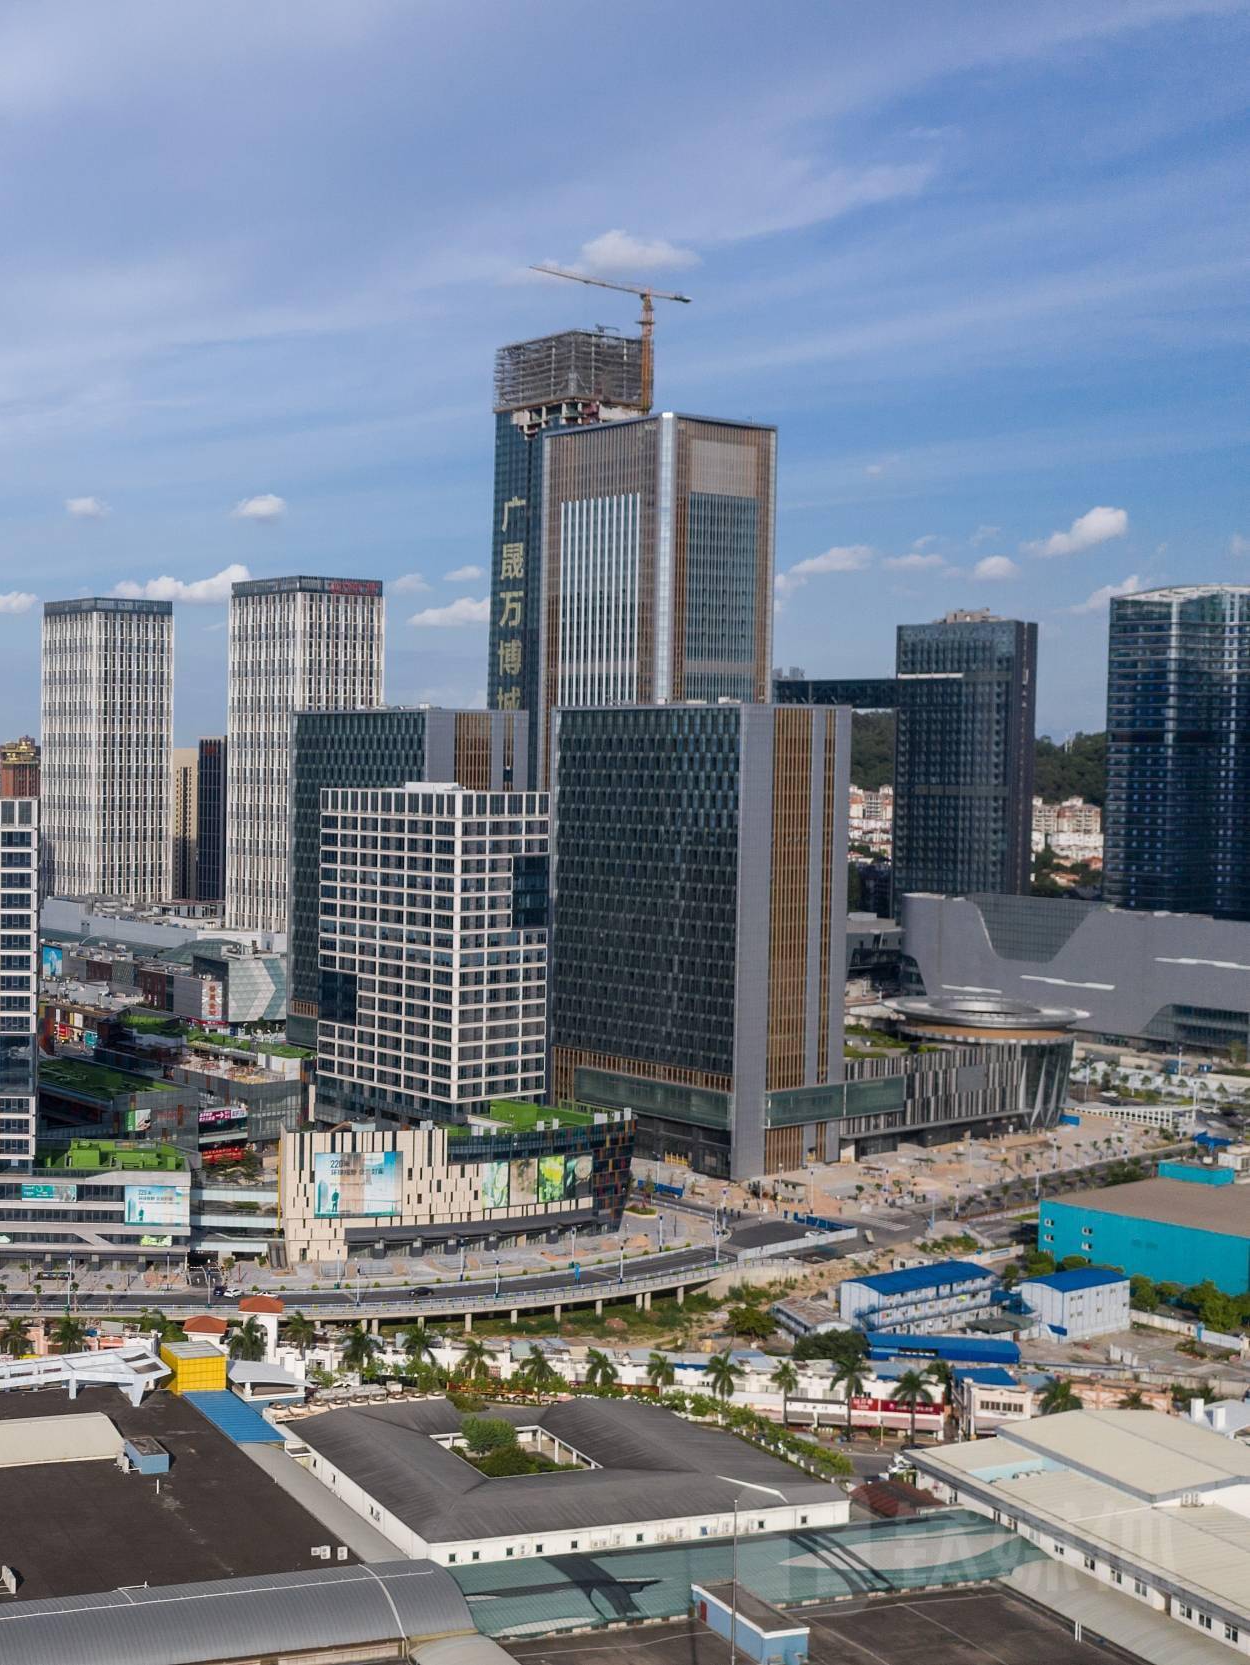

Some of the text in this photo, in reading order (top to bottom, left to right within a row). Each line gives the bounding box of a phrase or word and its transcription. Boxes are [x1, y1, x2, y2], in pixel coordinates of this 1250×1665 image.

[497, 496, 526, 711] 广晟万博城
